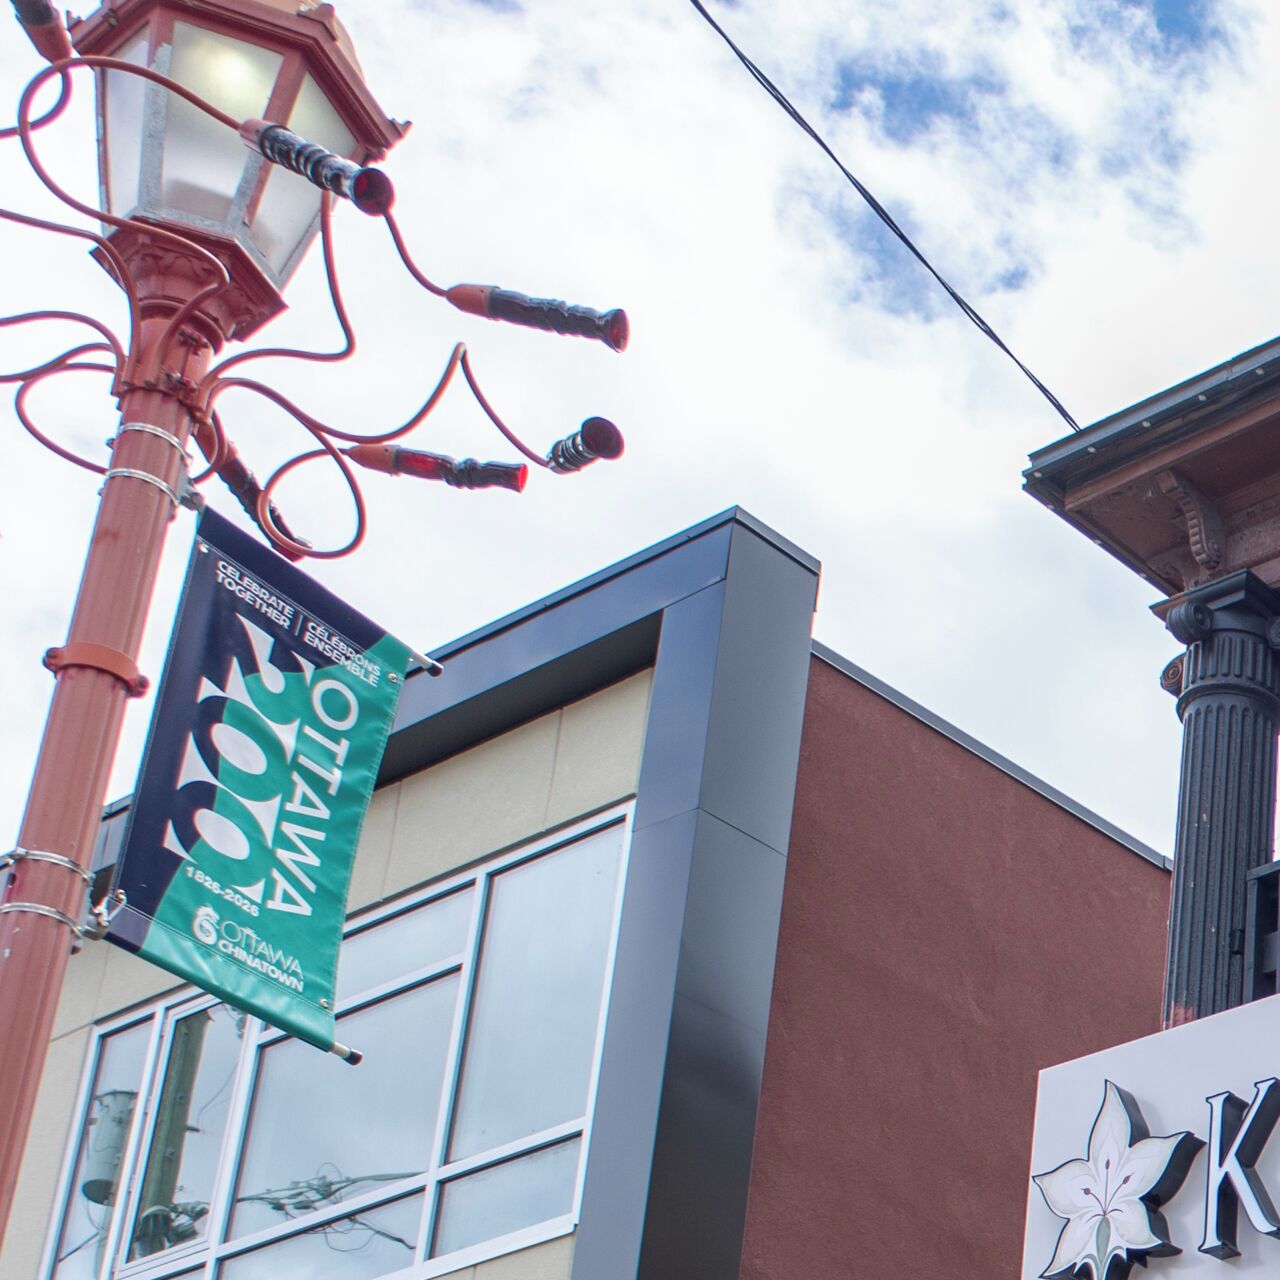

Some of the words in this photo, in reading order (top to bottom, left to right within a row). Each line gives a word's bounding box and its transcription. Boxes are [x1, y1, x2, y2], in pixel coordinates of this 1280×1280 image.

[217, 570, 291, 629] TOGETHER
[218, 561, 295, 618] CELEBRATE
[304, 632, 379, 687] ENSEMBLE
[265, 679, 359, 916] OTTAWA
[185, 866, 260, 917] 1826-2026
[218, 940, 304, 992] CHINATOWN
[221, 920, 304, 980] OTTAWA
